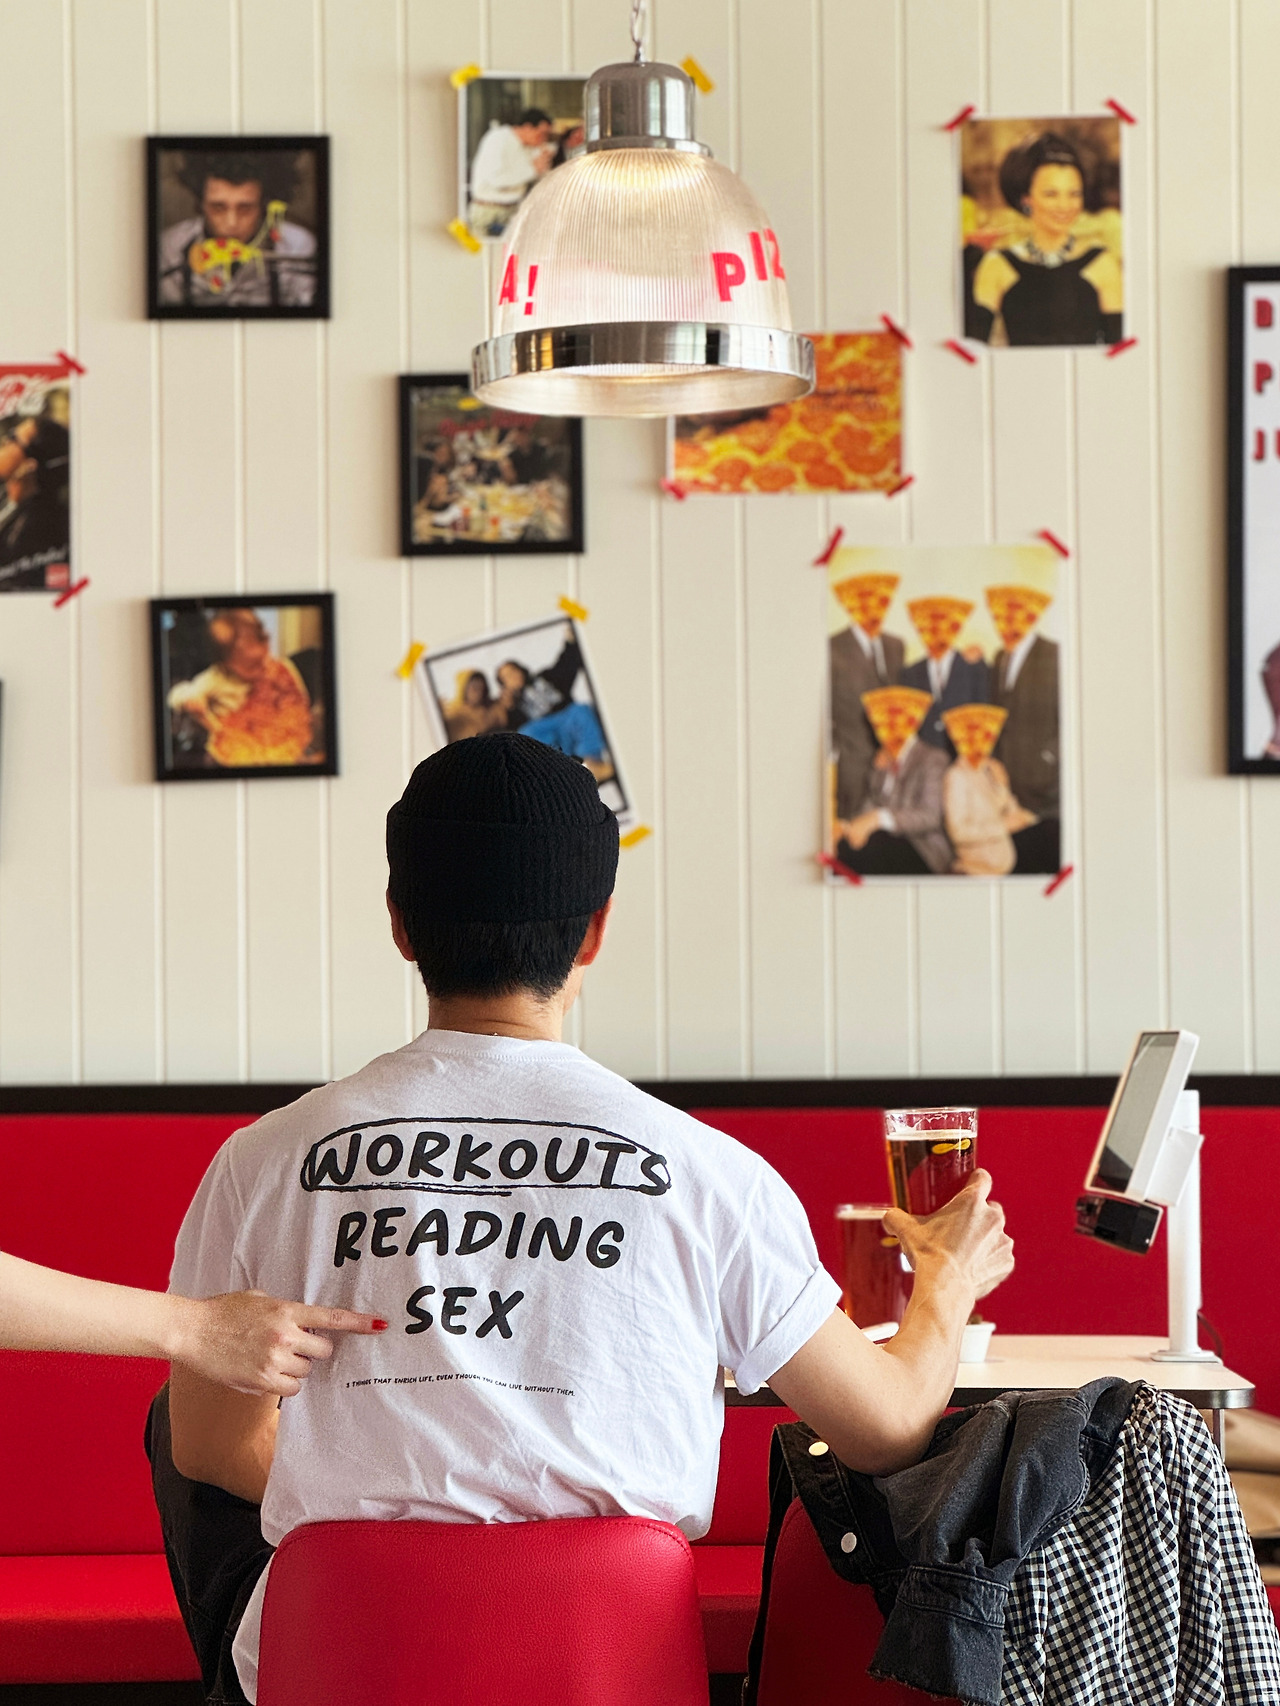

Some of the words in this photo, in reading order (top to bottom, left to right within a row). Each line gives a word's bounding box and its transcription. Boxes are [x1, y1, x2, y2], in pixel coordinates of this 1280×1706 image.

[311, 1131, 669, 1195] WORKOUTS
[334, 1207, 625, 1269] READING
[405, 1285, 525, 1339] SEX
[352, 1379, 372, 1387] THINGS
[394, 1376, 417, 1384] ENRICH
[524, 1385, 555, 1393] WITHOUT
[556, 1388, 575, 1396] THEM.
